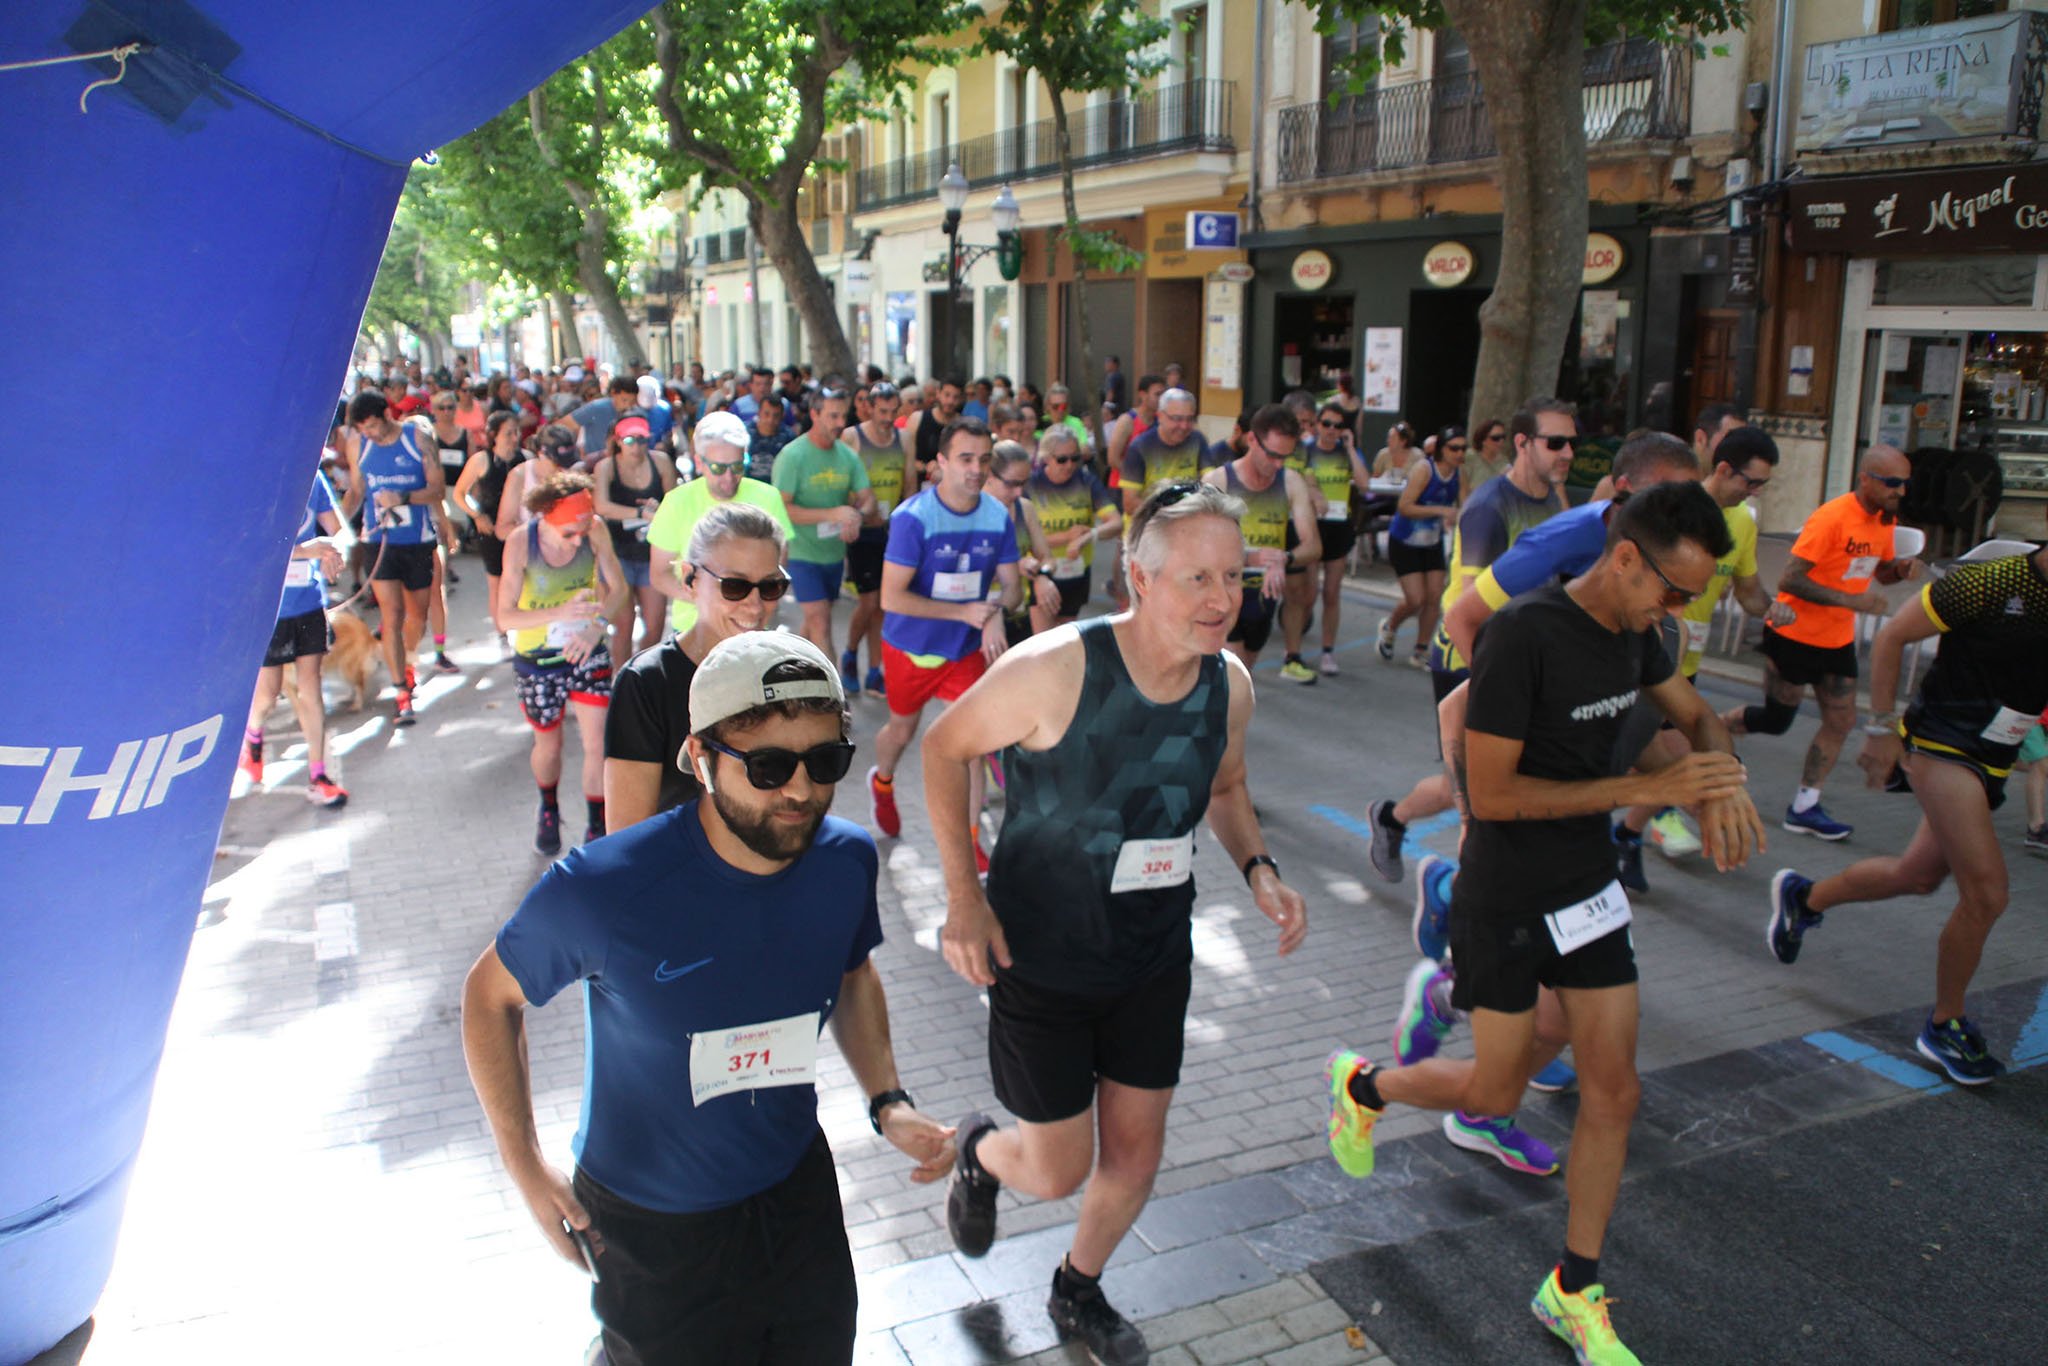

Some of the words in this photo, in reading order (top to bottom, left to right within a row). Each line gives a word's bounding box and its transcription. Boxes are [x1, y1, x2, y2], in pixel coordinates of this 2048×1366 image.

[1862, 55, 1893, 81] LA
[1906, 41, 1990, 75] REINA
[1298, 263, 1326, 278] VALOR
[1428, 256, 1466, 274] VALOR
[1142, 859, 1173, 875] 326
[1584, 896, 1609, 918] 318
[728, 1049, 772, 1072] 371
